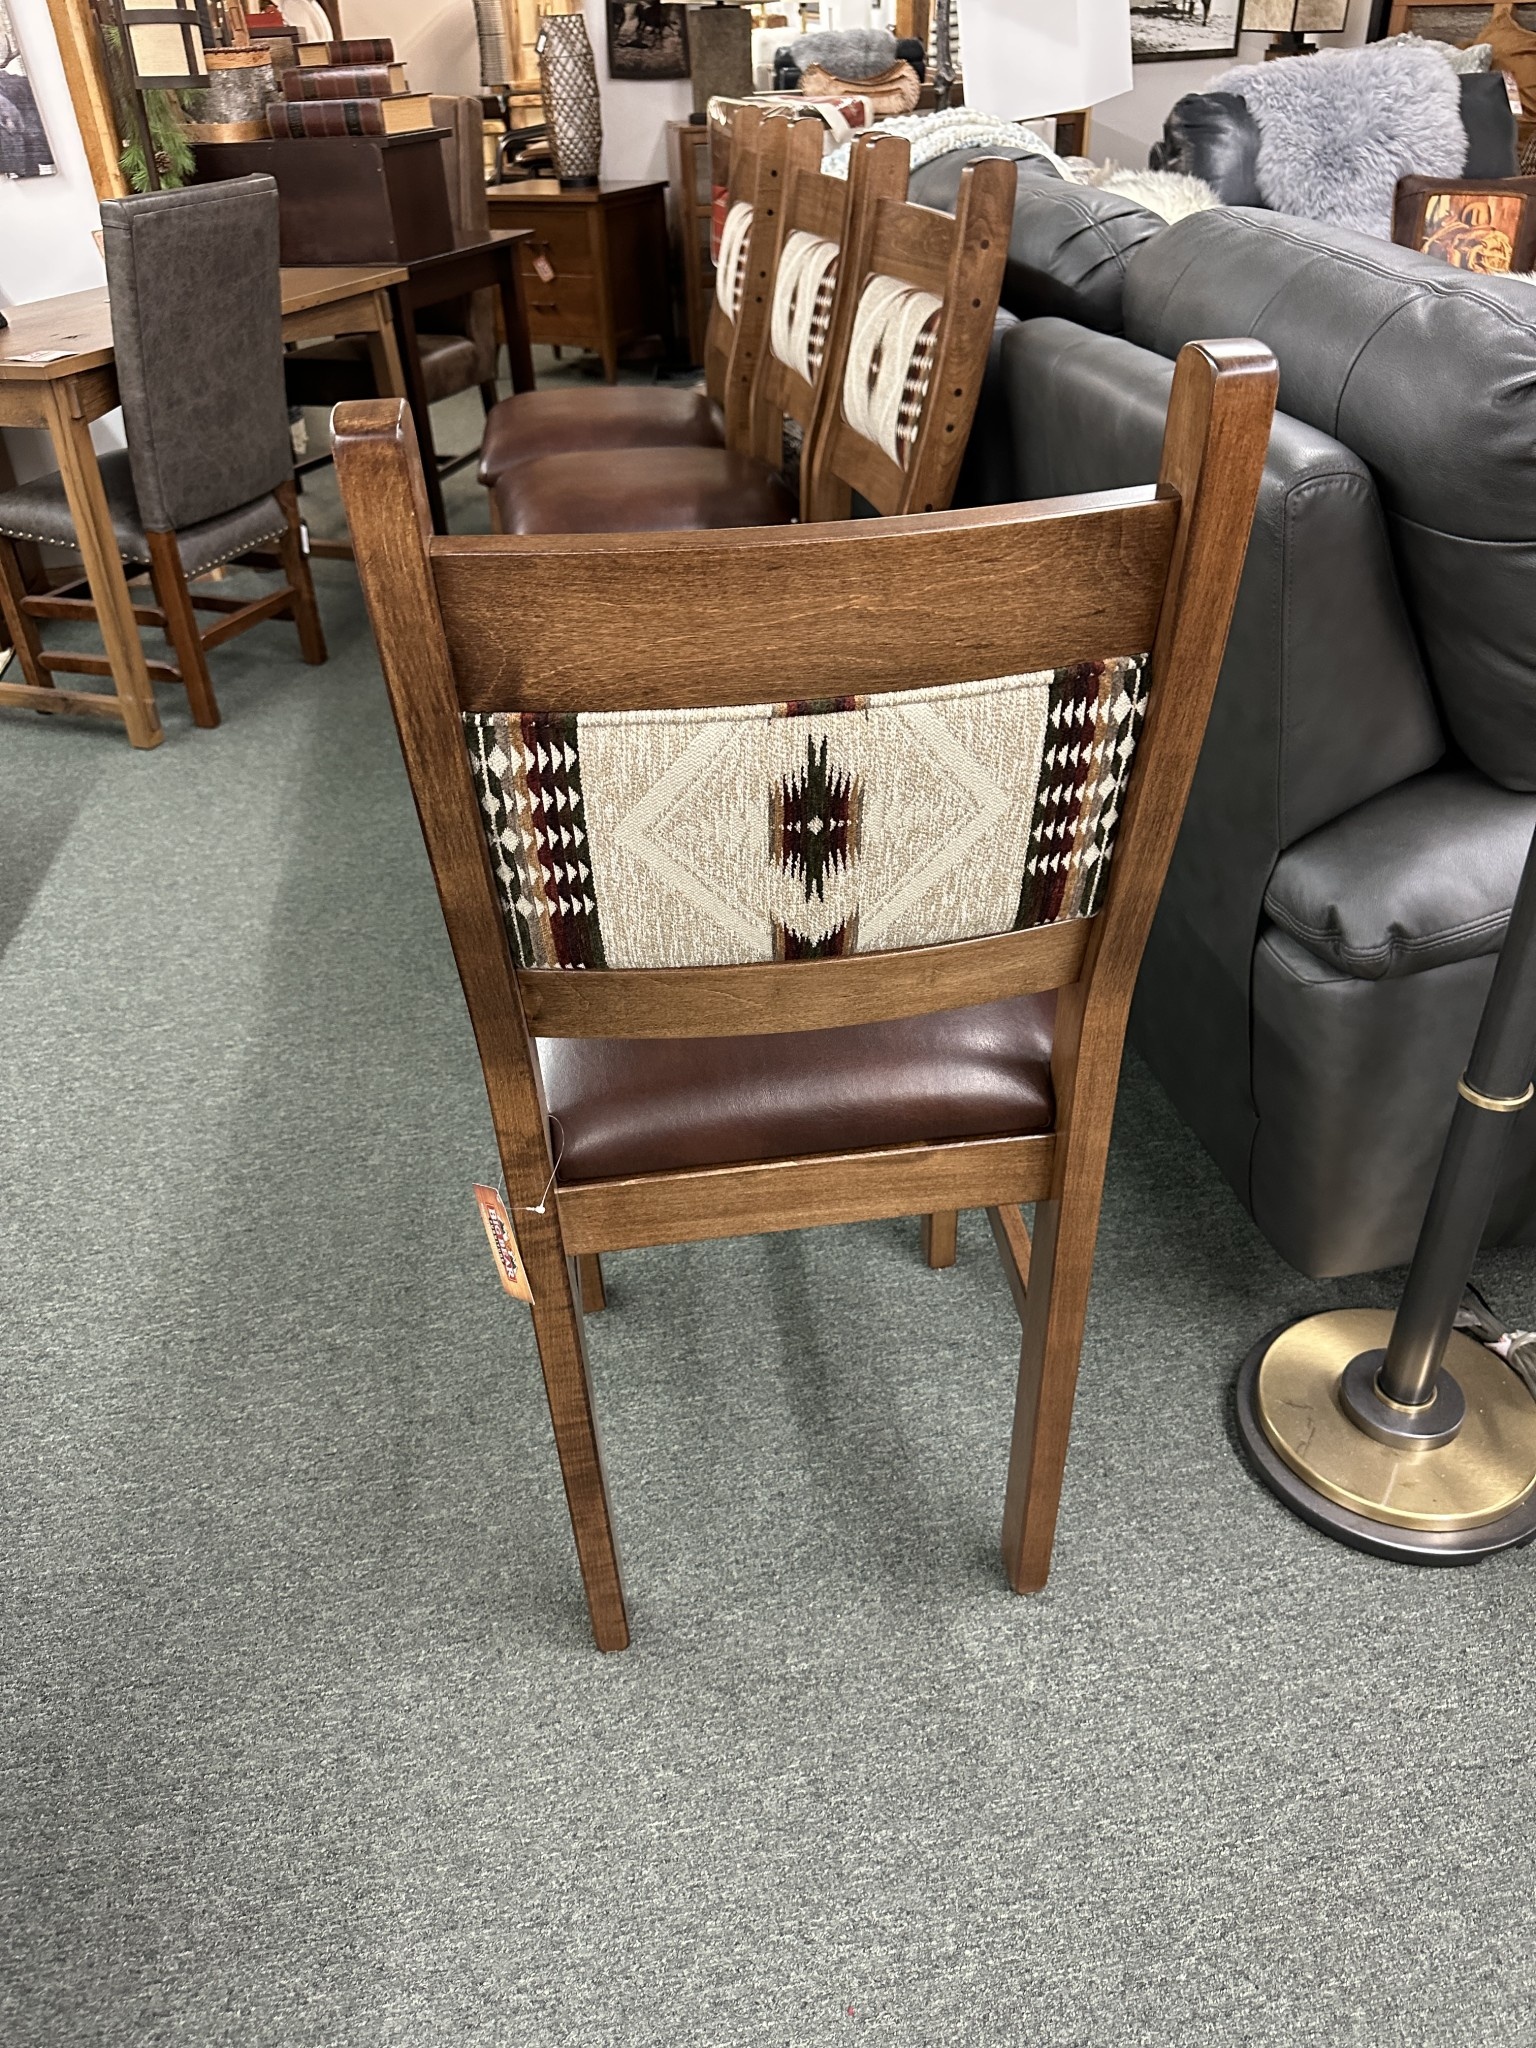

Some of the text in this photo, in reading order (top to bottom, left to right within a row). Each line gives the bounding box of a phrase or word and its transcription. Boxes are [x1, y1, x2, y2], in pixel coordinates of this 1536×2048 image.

[487, 1208, 515, 1277] BIG BEAR
[488, 1218, 505, 1263] FURNITURE
